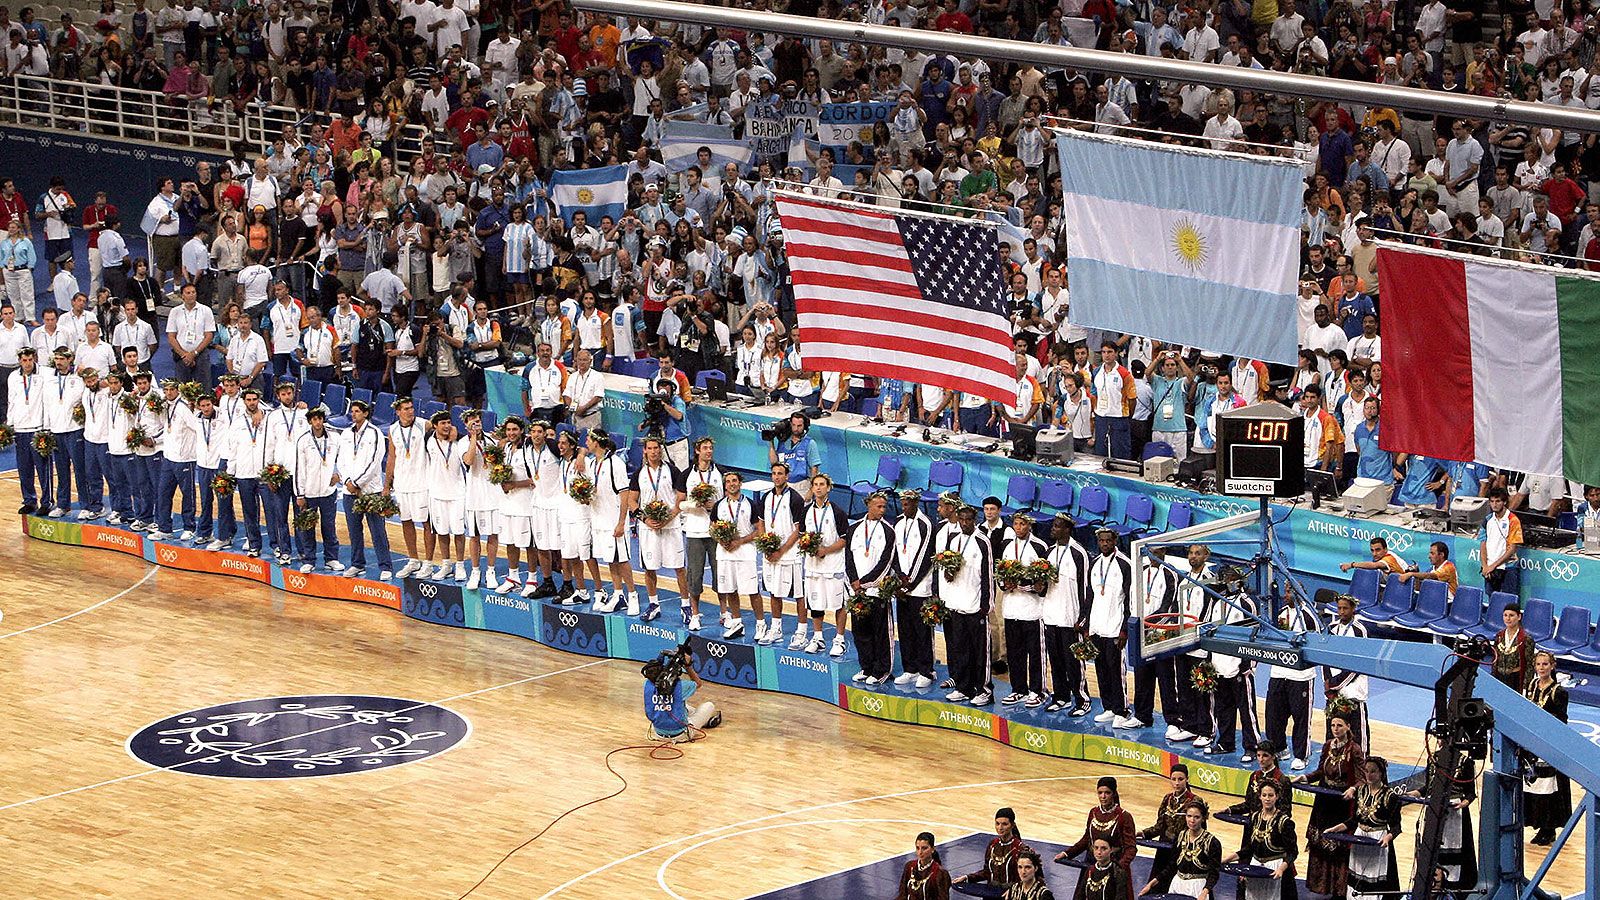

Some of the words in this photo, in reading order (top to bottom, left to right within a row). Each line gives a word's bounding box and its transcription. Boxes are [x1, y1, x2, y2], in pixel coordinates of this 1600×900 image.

[627, 401, 644, 413] 200
[720, 416, 755, 431] ATHENS
[1227, 483, 1265, 491] swatch
[1307, 519, 1349, 538] ATHENS
[97, 531, 123, 544] ATHENS
[123, 536, 137, 548] 2004
[221, 558, 249, 572] ATHENS
[249, 564, 263, 575] 2004
[1520, 557, 1542, 571] 004
[353, 584, 382, 598] ATHENS
[381, 590, 396, 601] 2004
[485, 594, 514, 608] ATHENS
[514, 600, 530, 612] 2004
[630, 623, 660, 637] ATHENS
[660, 628, 676, 641] 2004
[1237, 646, 1262, 657] ATHENS
[1262, 650, 1278, 660] 2004
[779, 655, 812, 670] ATHENS
[811, 661, 829, 673] 2004
[939, 710, 973, 725] ATHENS
[973, 716, 991, 730] 2004
[1105, 745, 1141, 761] ATHENS
[1141, 752, 1160, 766] 2004
